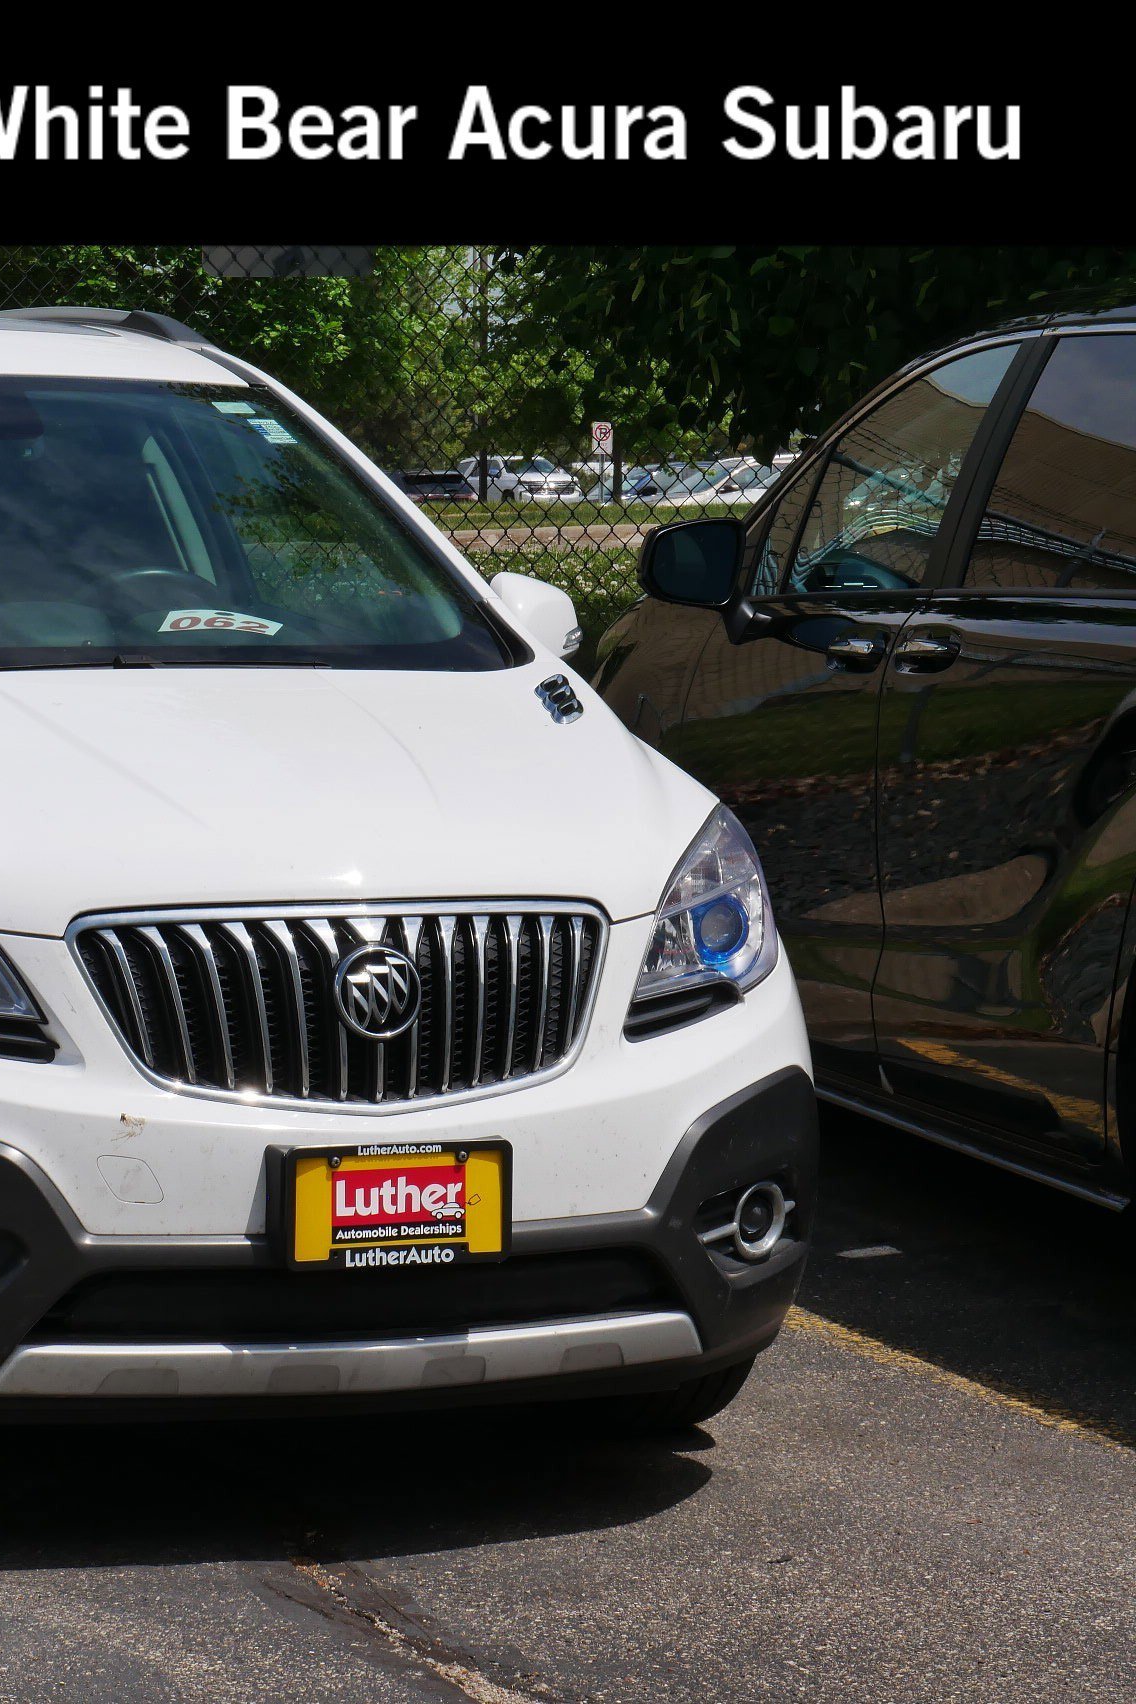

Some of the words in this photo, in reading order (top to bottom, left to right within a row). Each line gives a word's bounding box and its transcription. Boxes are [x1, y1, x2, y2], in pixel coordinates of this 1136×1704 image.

[169, 615, 270, 633] 062
[357, 1144, 442, 1156] LutherAuto.com
[335, 1176, 463, 1217] Luther
[336, 1226, 398, 1240] Automobile
[400, 1222, 462, 1236] Dealerships
[345, 1246, 454, 1268] LutherAuto
